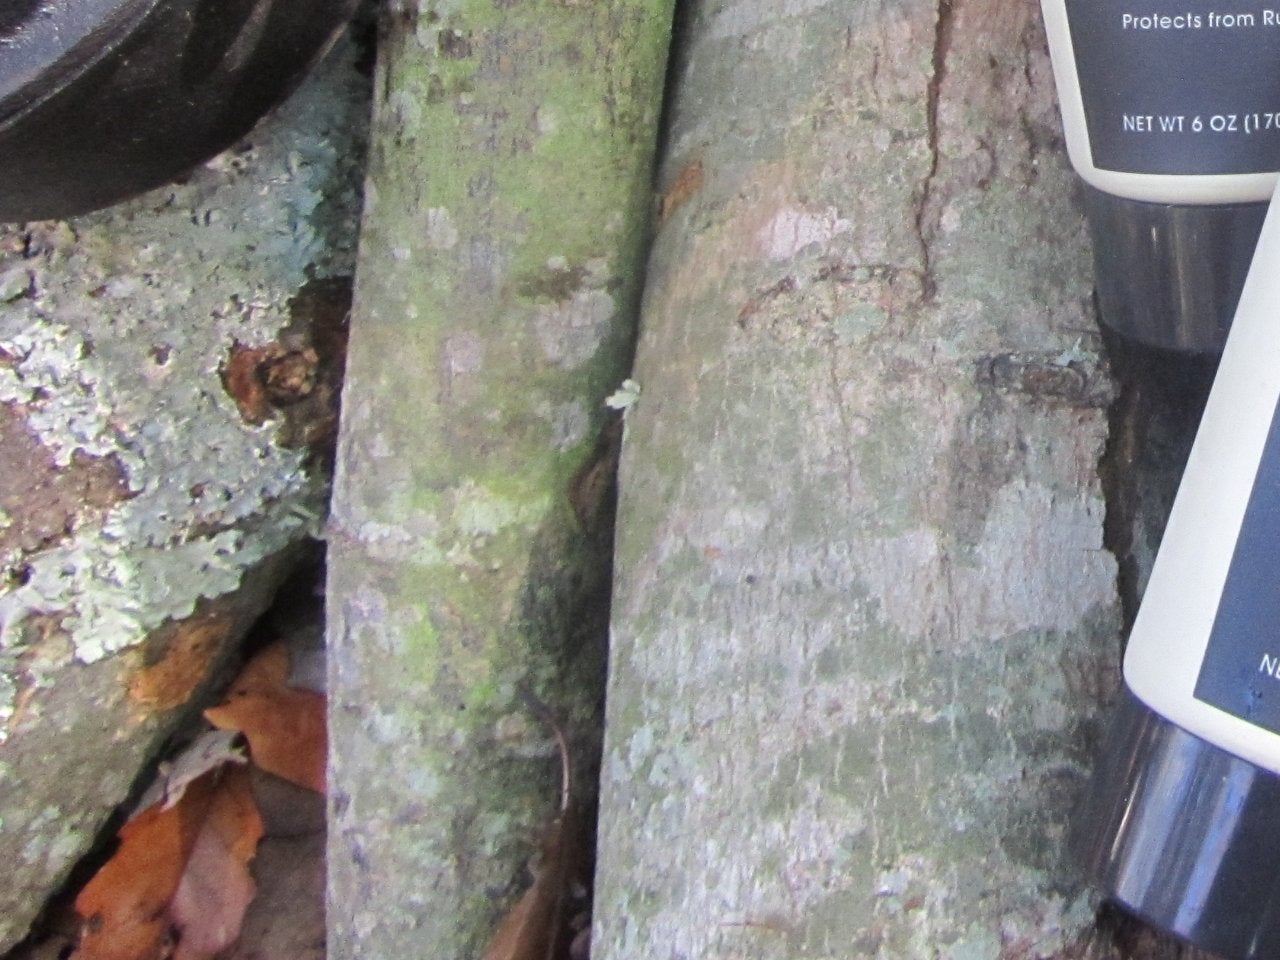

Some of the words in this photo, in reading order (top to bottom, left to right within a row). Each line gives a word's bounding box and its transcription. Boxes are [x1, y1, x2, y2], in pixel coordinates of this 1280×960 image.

[1122, 12, 1202, 29] Protects
[1209, 12, 1254, 28] from
[1123, 115, 1152, 132] NET
[1159, 116, 1184, 132] WT
[1192, 114, 1202, 132] 6
[1210, 114, 1237, 131] OZ
